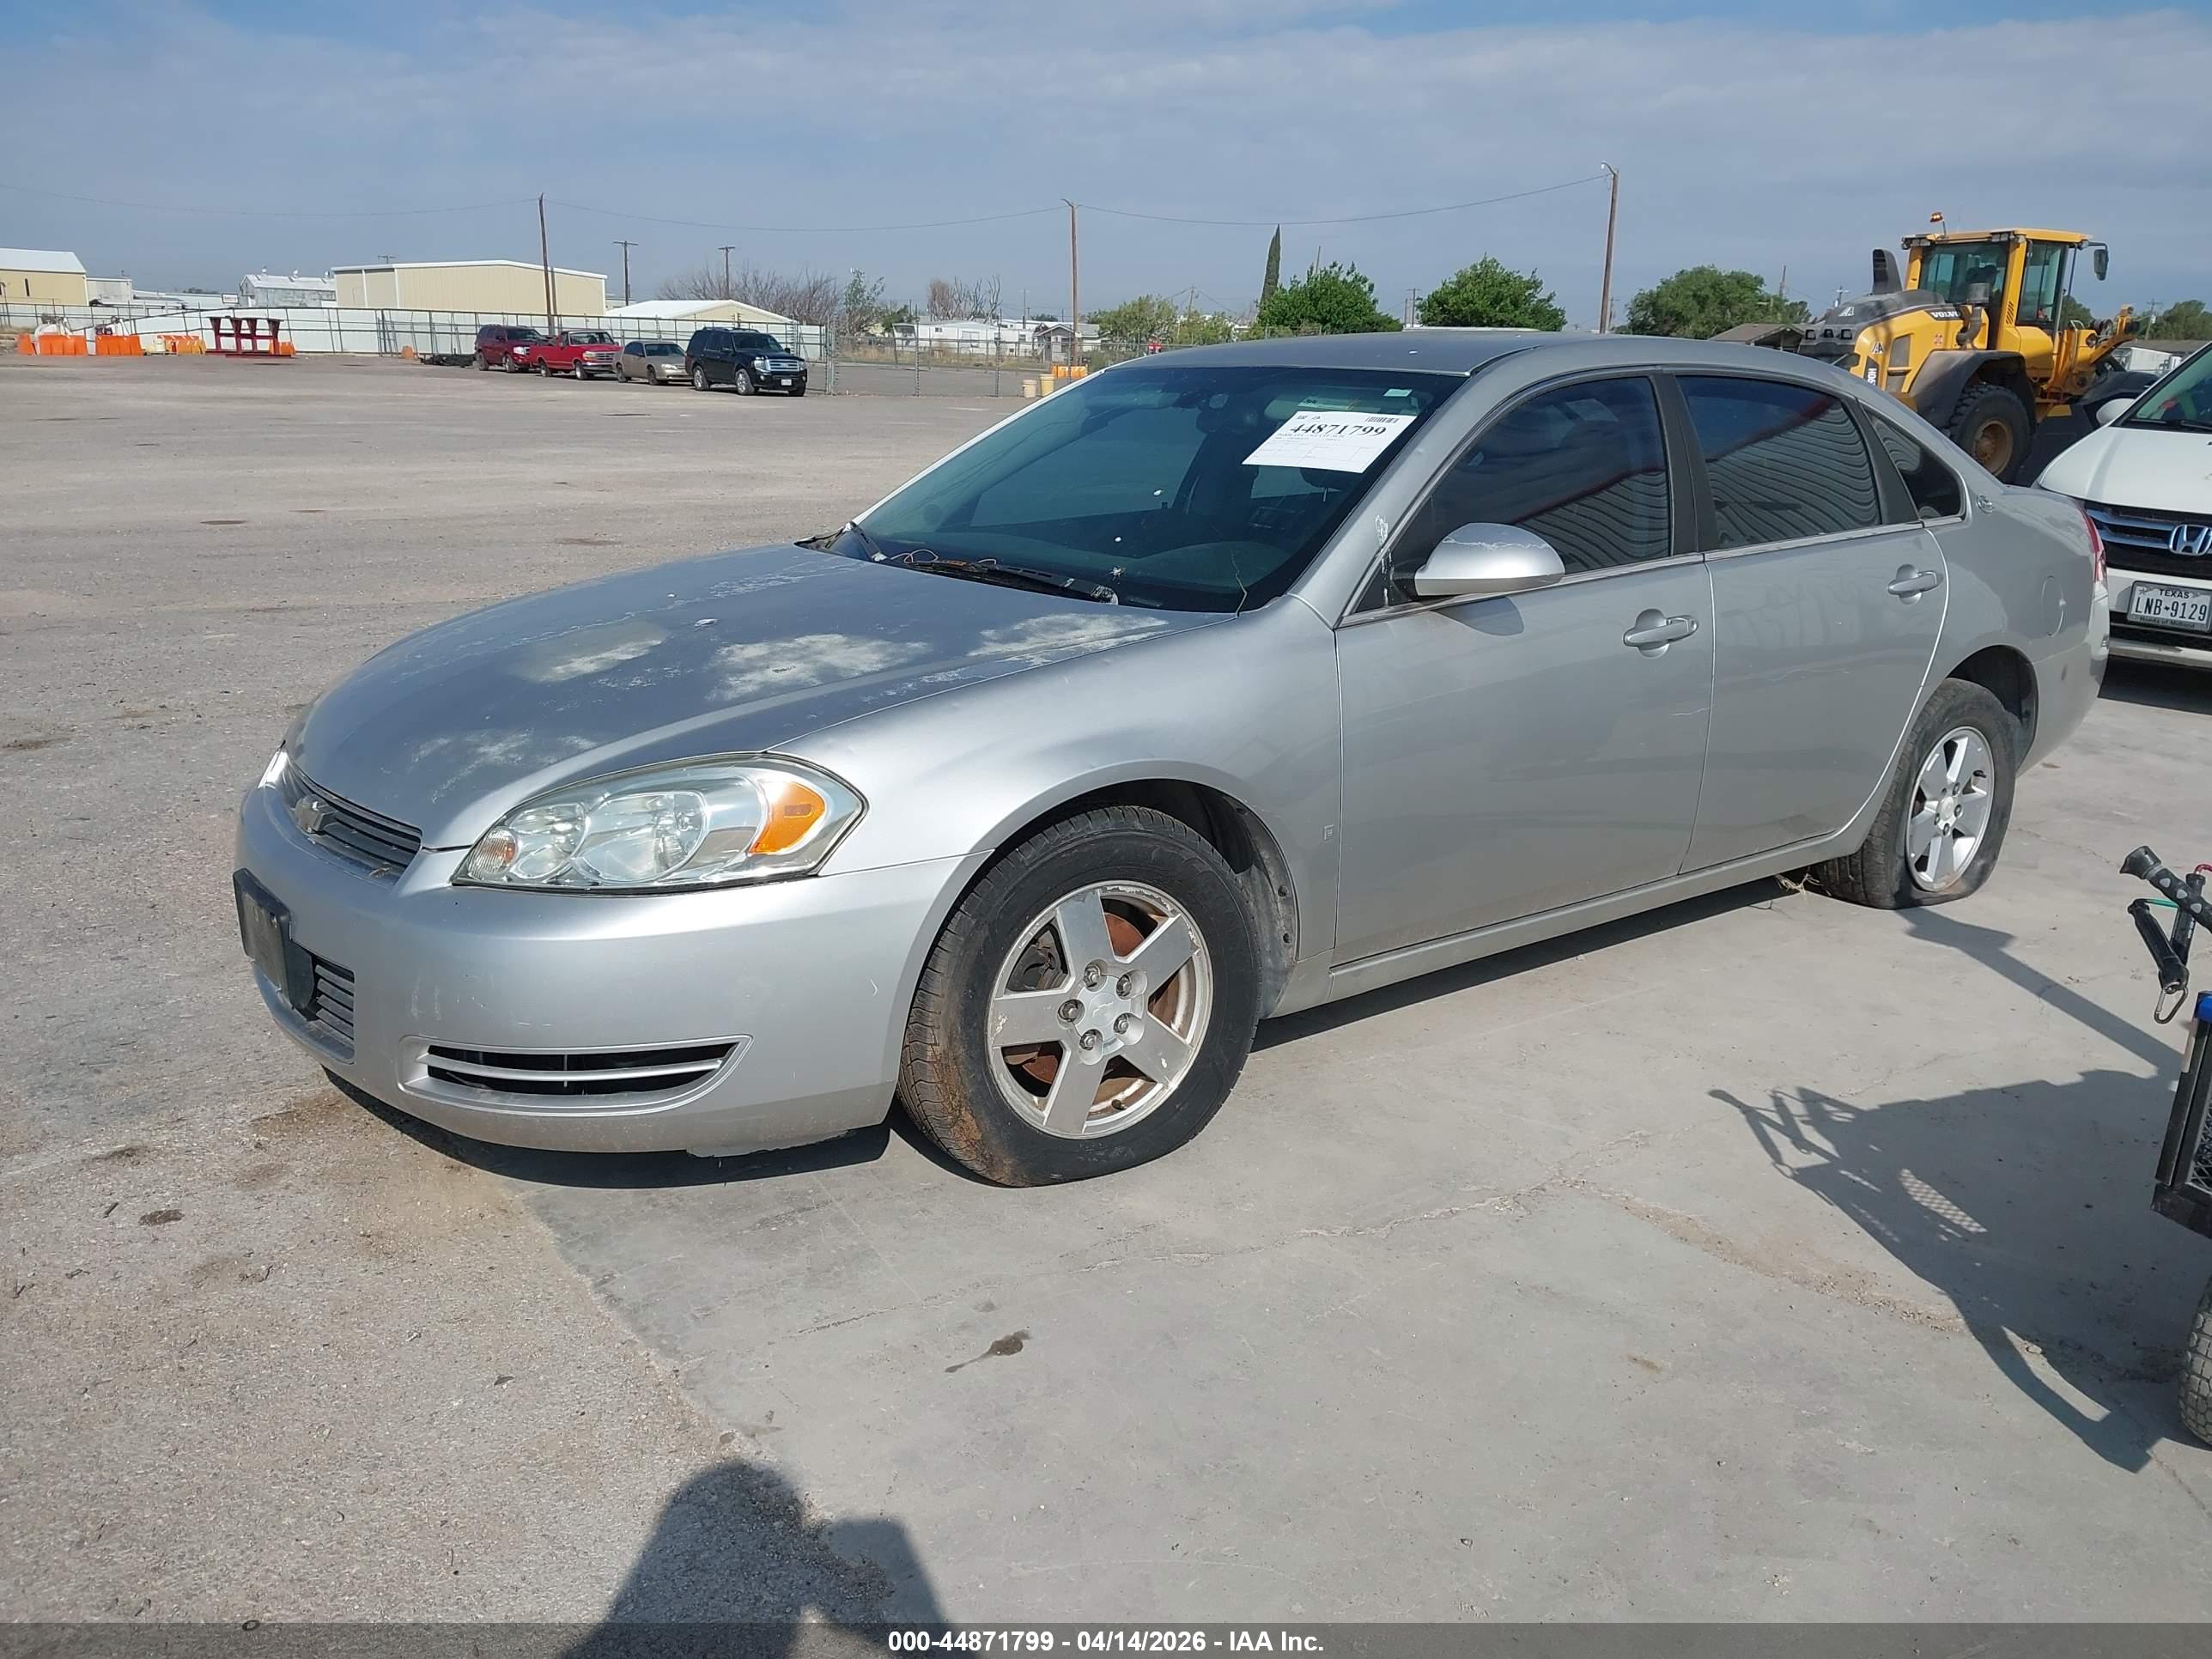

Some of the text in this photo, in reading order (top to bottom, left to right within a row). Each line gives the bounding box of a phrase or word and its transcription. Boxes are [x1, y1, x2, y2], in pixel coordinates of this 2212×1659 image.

[1868, 368, 1877, 385] 90H
[1289, 423, 1387, 437] 44871799
[2160, 589, 2189, 599] TEXAS
